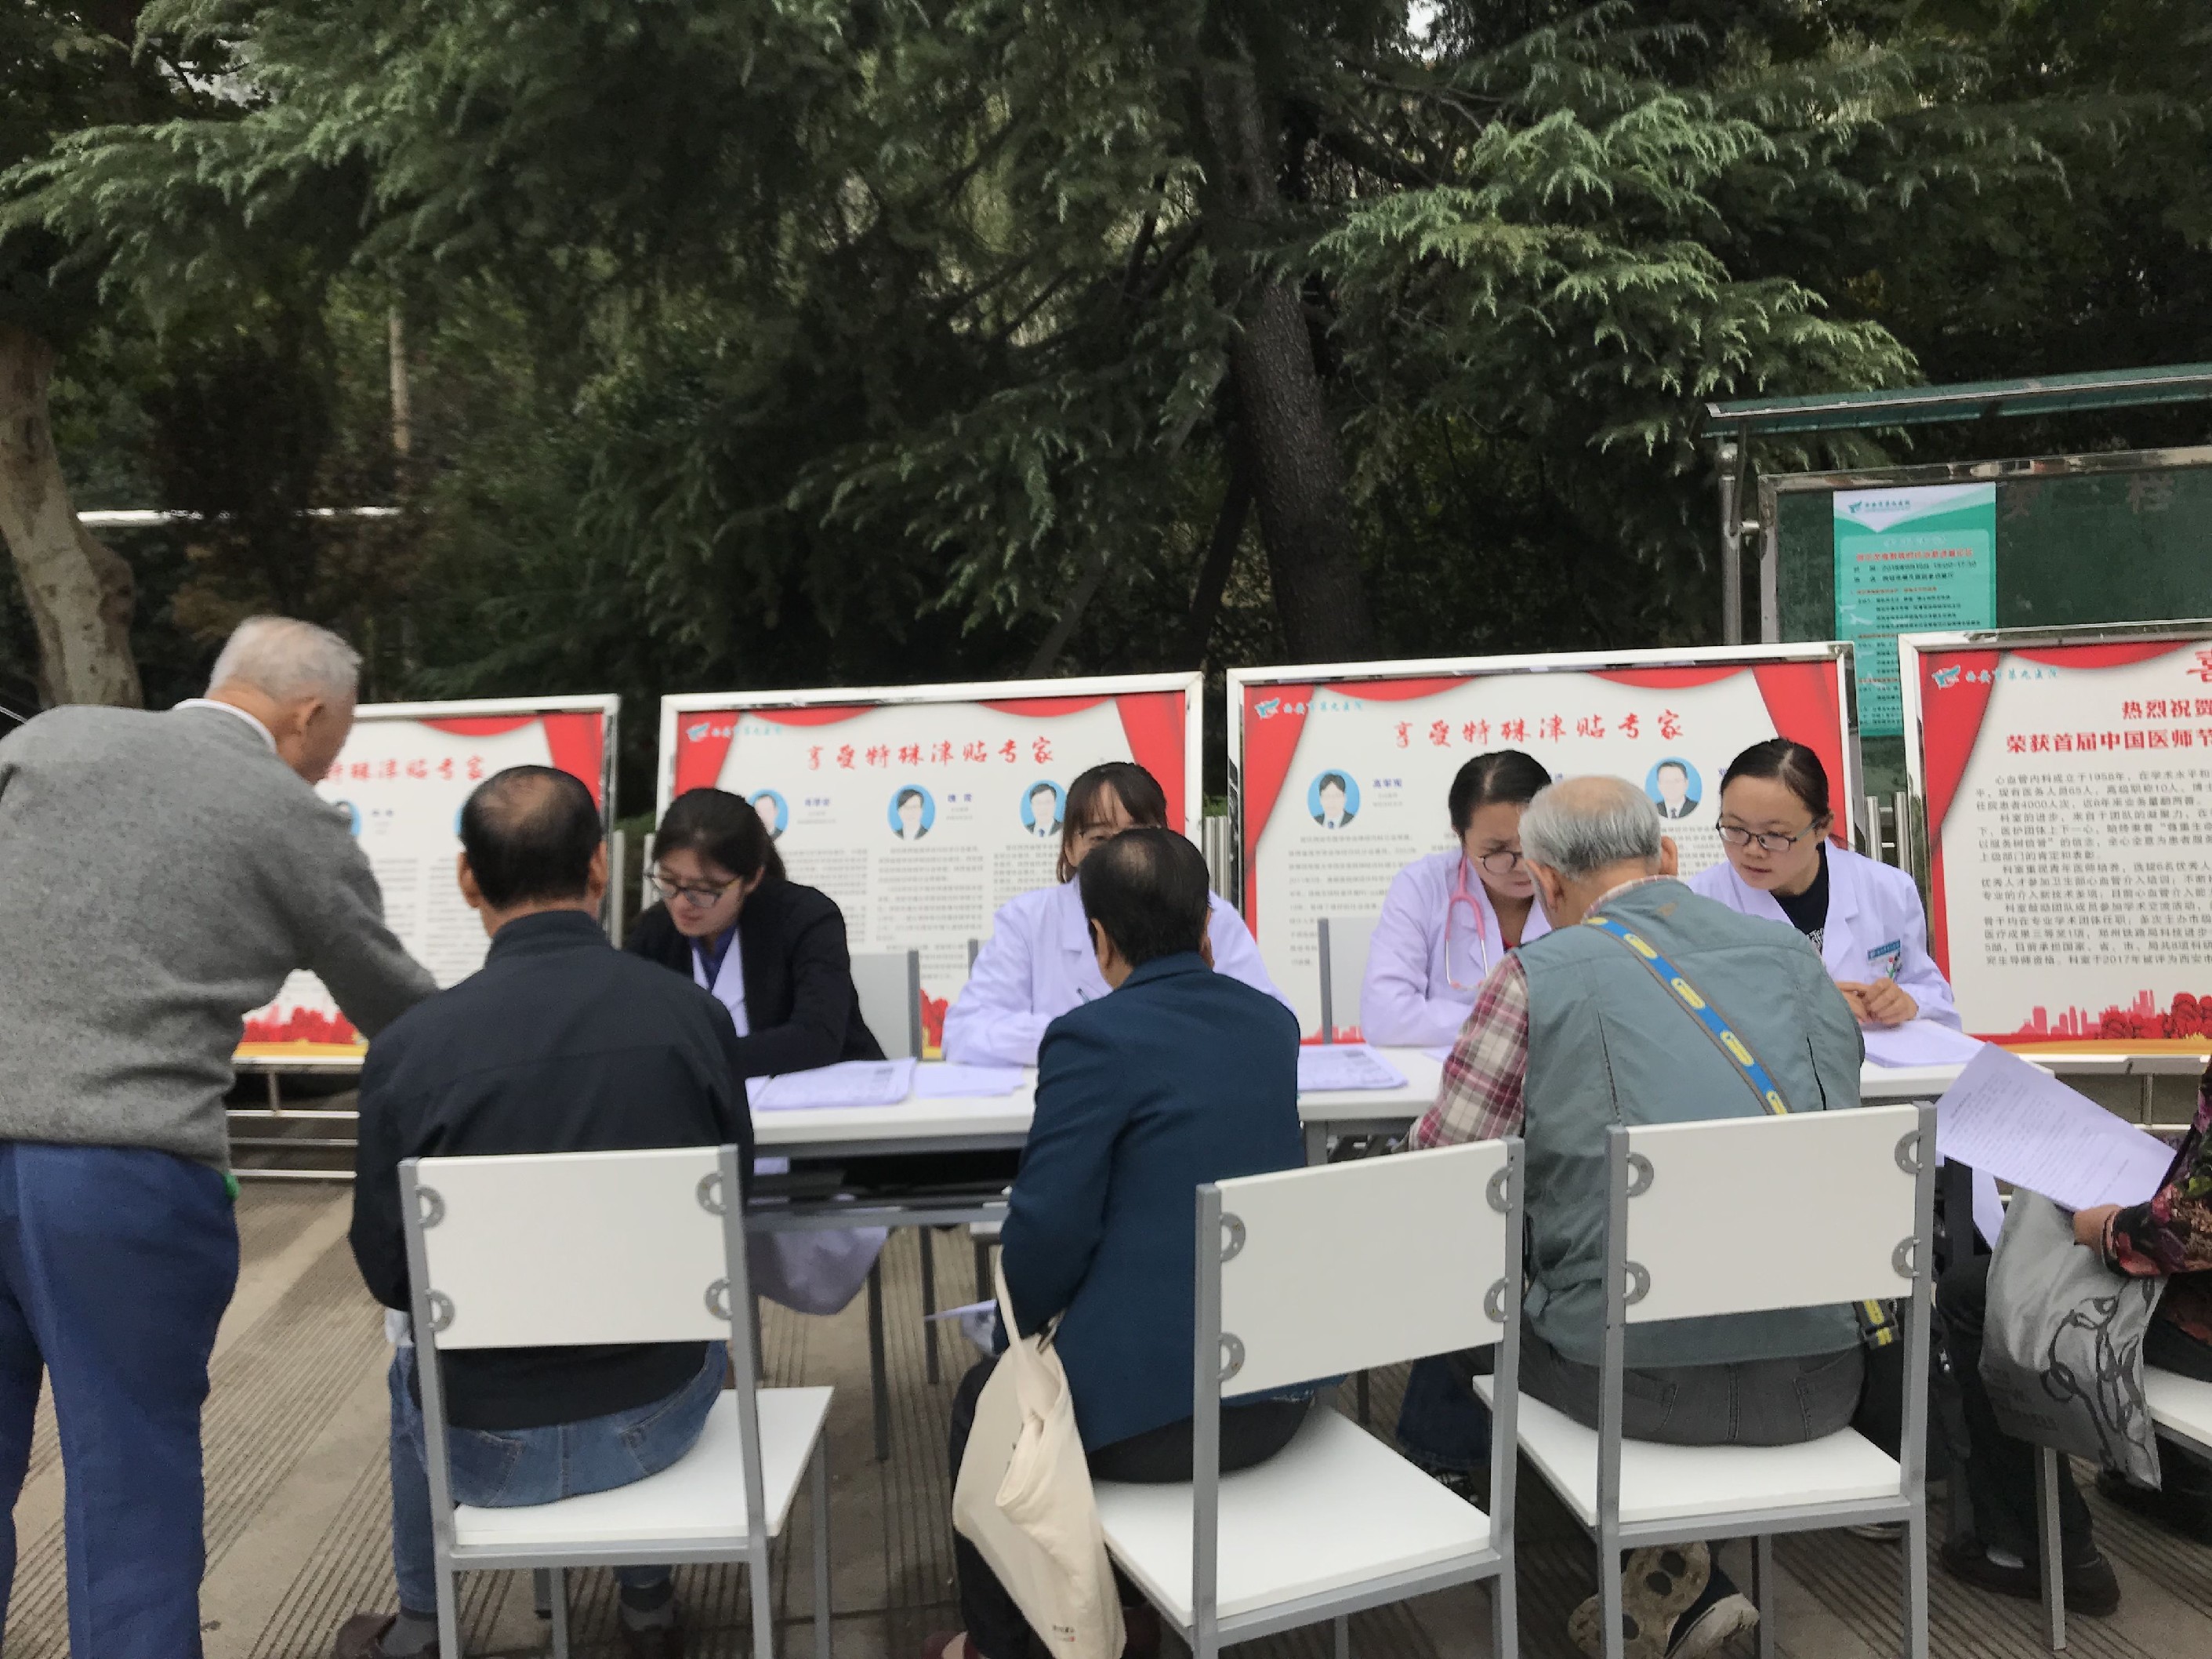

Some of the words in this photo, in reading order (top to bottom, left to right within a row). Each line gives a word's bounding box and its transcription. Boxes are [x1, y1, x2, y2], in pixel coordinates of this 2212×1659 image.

[1394, 709, 1684, 749] 享受特殊津贴专家
[807, 735, 1054, 771] 享受特殊津贴专家
